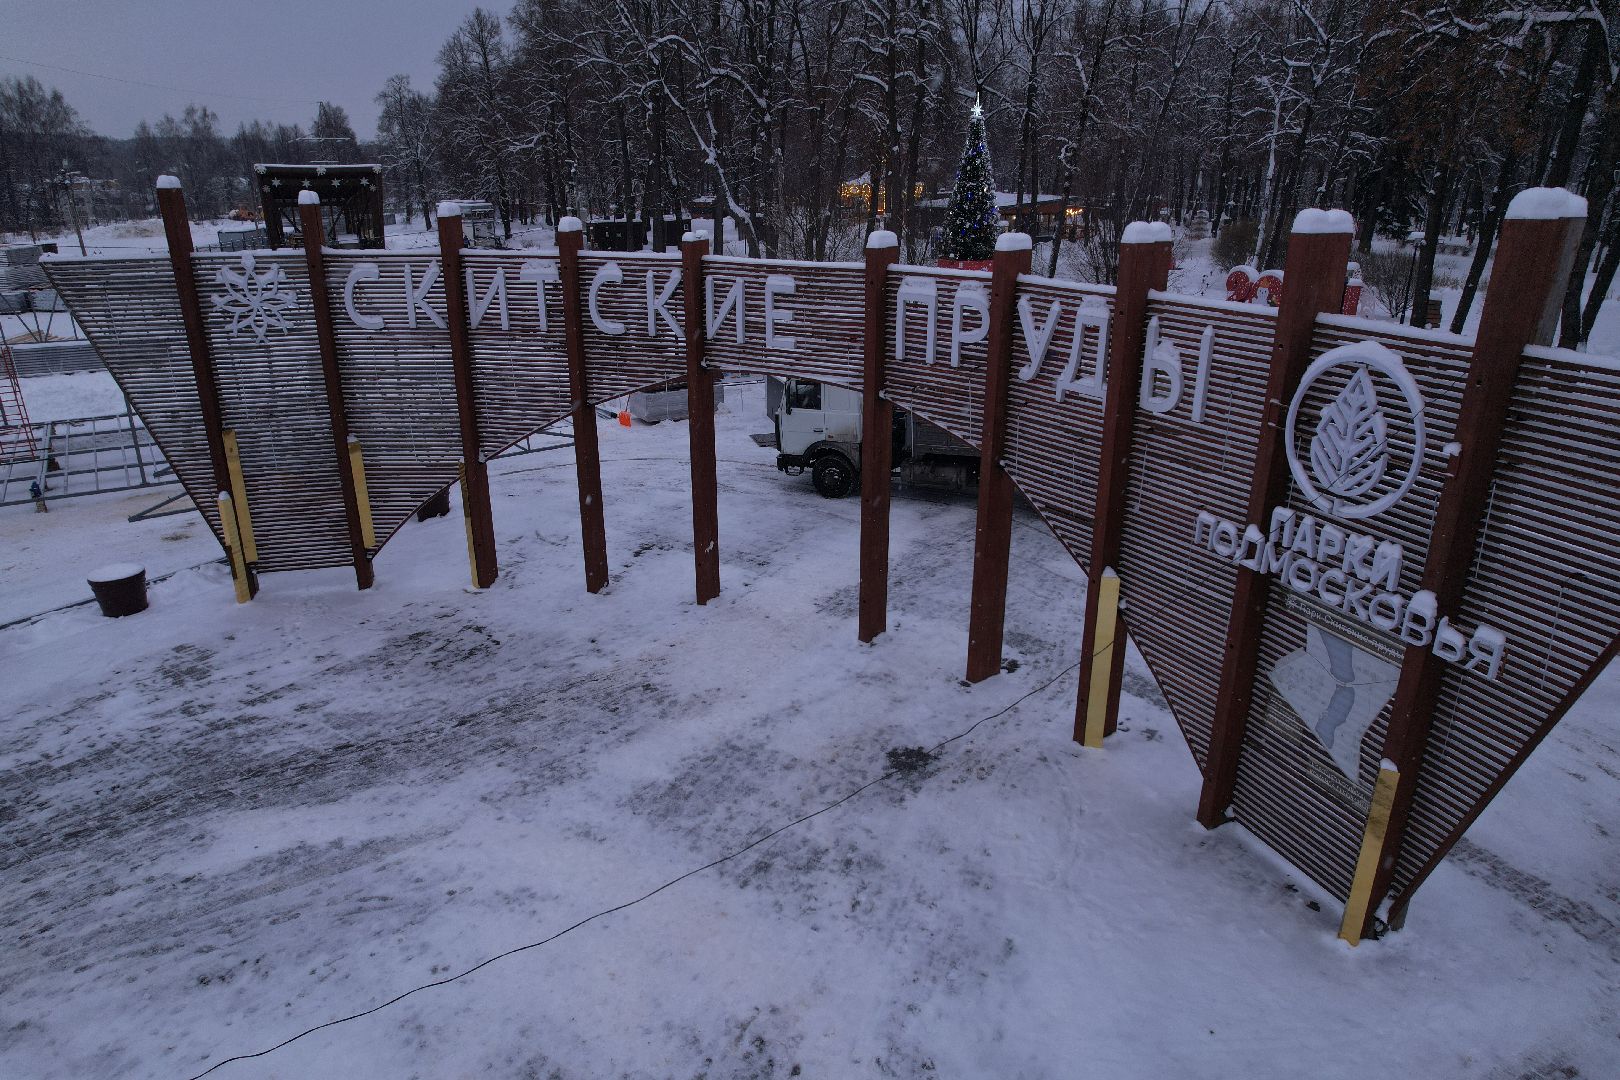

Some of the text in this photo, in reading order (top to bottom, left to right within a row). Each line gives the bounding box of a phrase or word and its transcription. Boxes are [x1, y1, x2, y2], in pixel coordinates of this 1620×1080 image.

[344, 260, 1214, 423] СКИТСКИЕ ПРУДЫ
[1195, 510, 1506, 681] ПОДМОСКОВЬЯ
[1269, 506, 1403, 591] ПАРКИ
